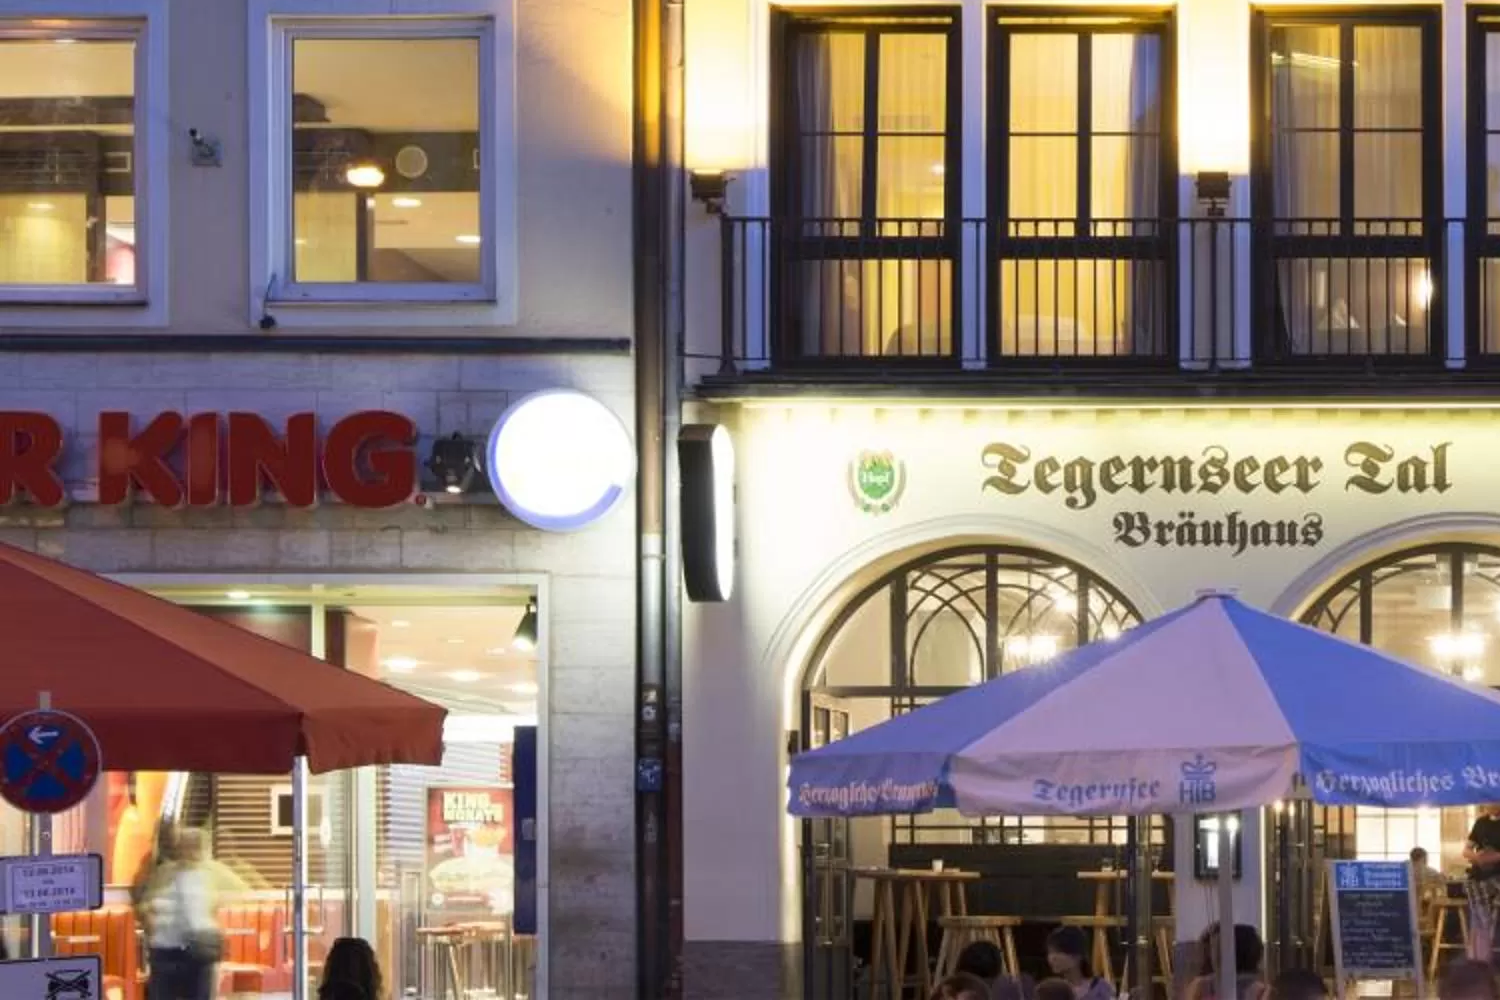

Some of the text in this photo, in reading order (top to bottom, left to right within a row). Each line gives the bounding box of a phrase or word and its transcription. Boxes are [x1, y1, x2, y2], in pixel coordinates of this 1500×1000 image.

[98, 410, 417, 509] KING
[981, 440, 1453, 510] Tegernseer Tal
[1112, 510, 1324, 556] Bräuhaus
[1034, 778, 1160, 806] Tegernsee
[1316, 770, 1454, 798] Herzogliches
